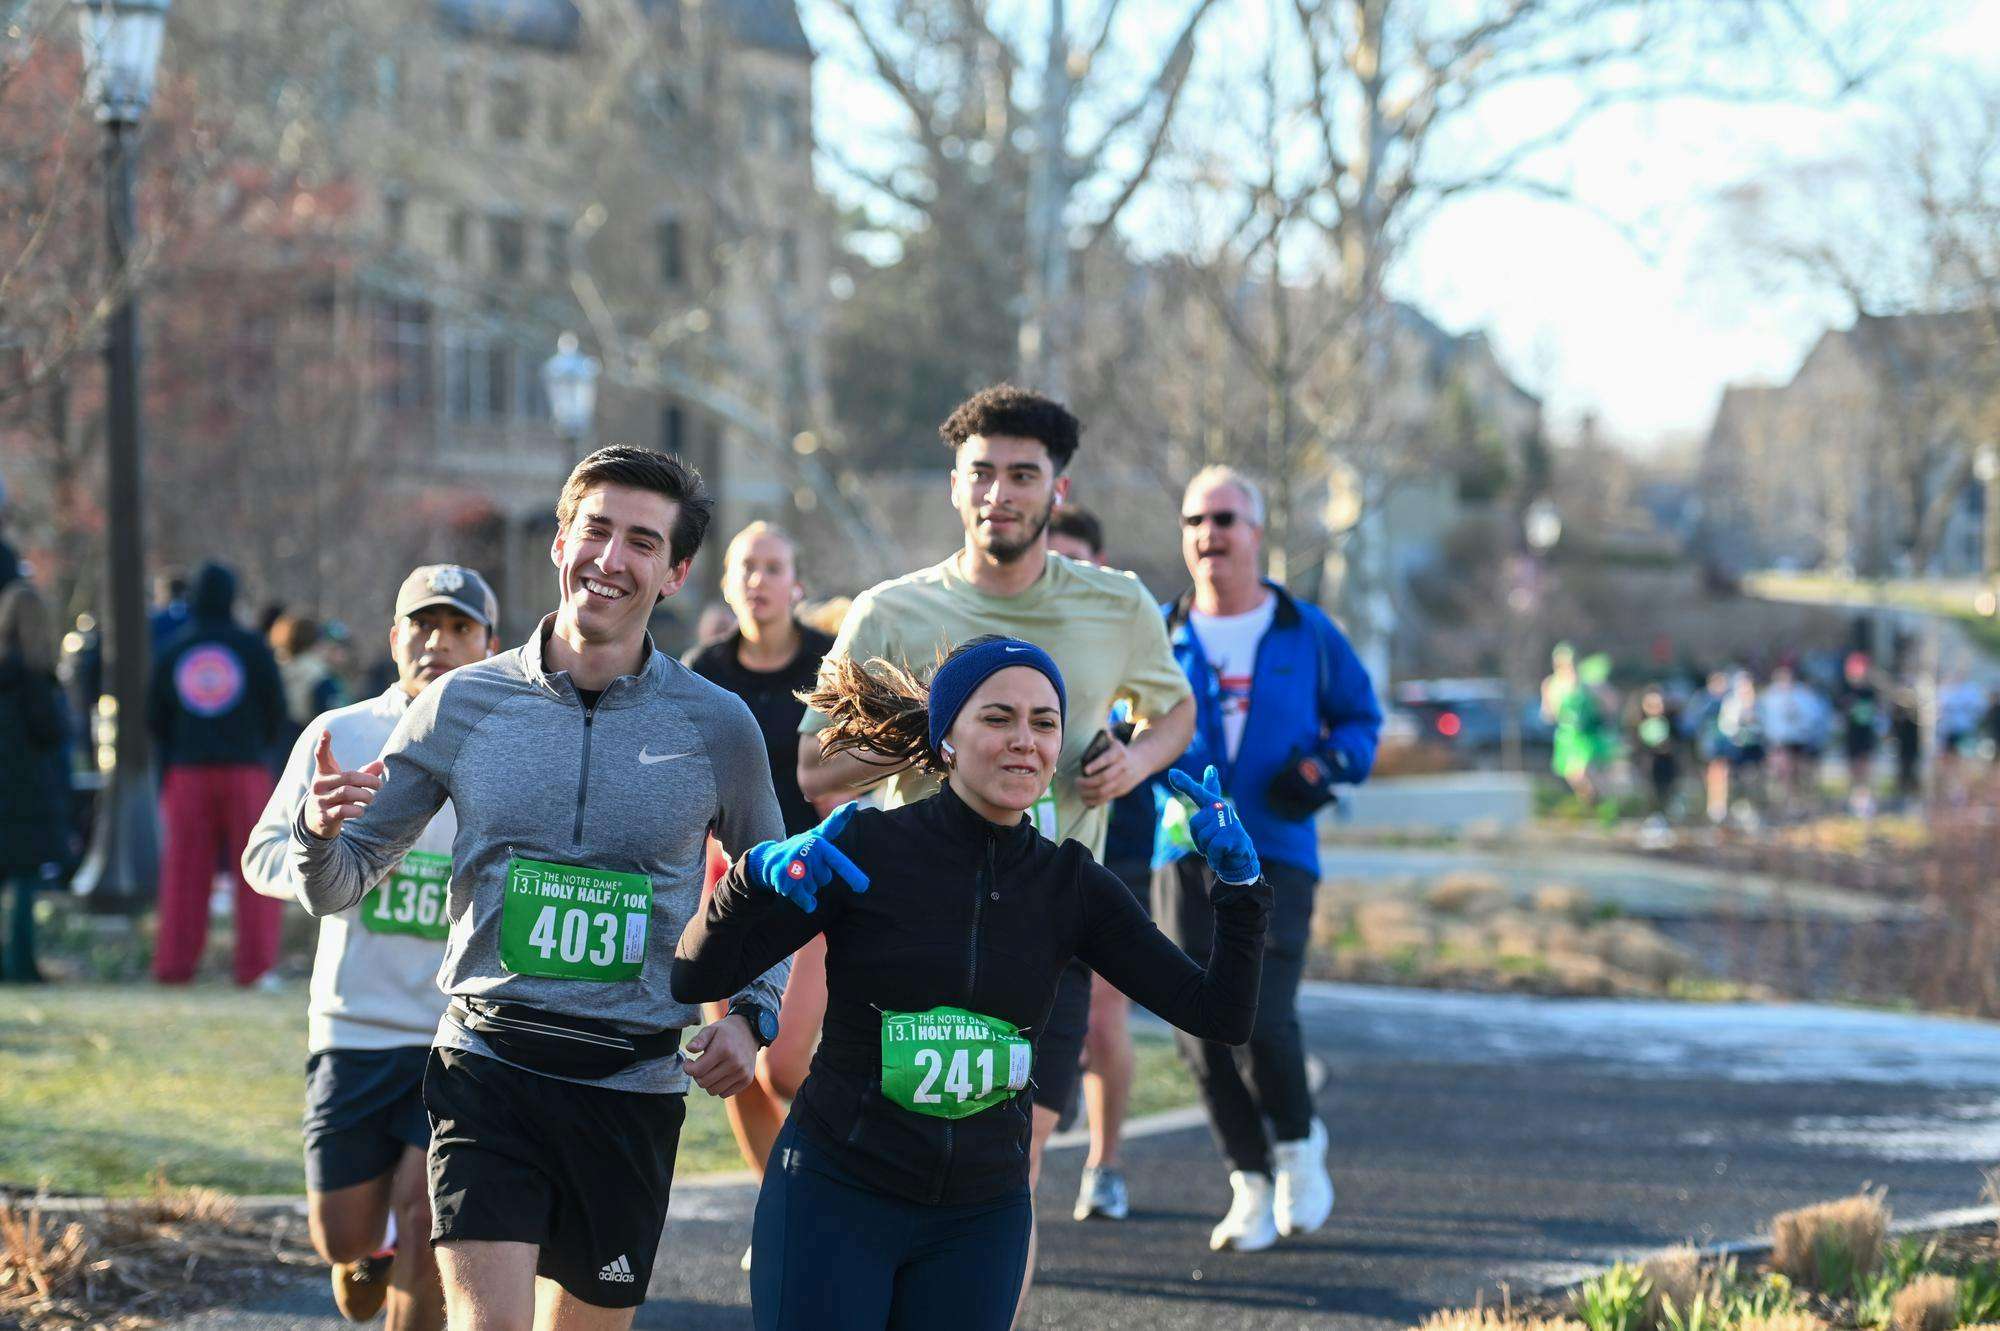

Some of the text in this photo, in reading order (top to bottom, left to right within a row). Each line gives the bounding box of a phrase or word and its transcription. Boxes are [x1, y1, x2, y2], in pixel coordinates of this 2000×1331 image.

[512, 876, 540, 896] 13.1
[543, 871, 560, 883] THE
[562, 875, 591, 887] NOTRE
[541, 881, 575, 901] HOLY
[577, 887, 611, 905] HALF
[622, 893, 648, 910] 10K
[528, 905, 618, 967] 403
[918, 1014, 935, 1025] THE
[937, 1014, 966, 1025] NOTRE
[887, 1023, 916, 1042] 13.1
[918, 1025, 953, 1041] HOLY
[955, 1025, 990, 1041] HALF
[912, 1048, 994, 1104] 241
[598, 1271, 635, 1282] adidas
